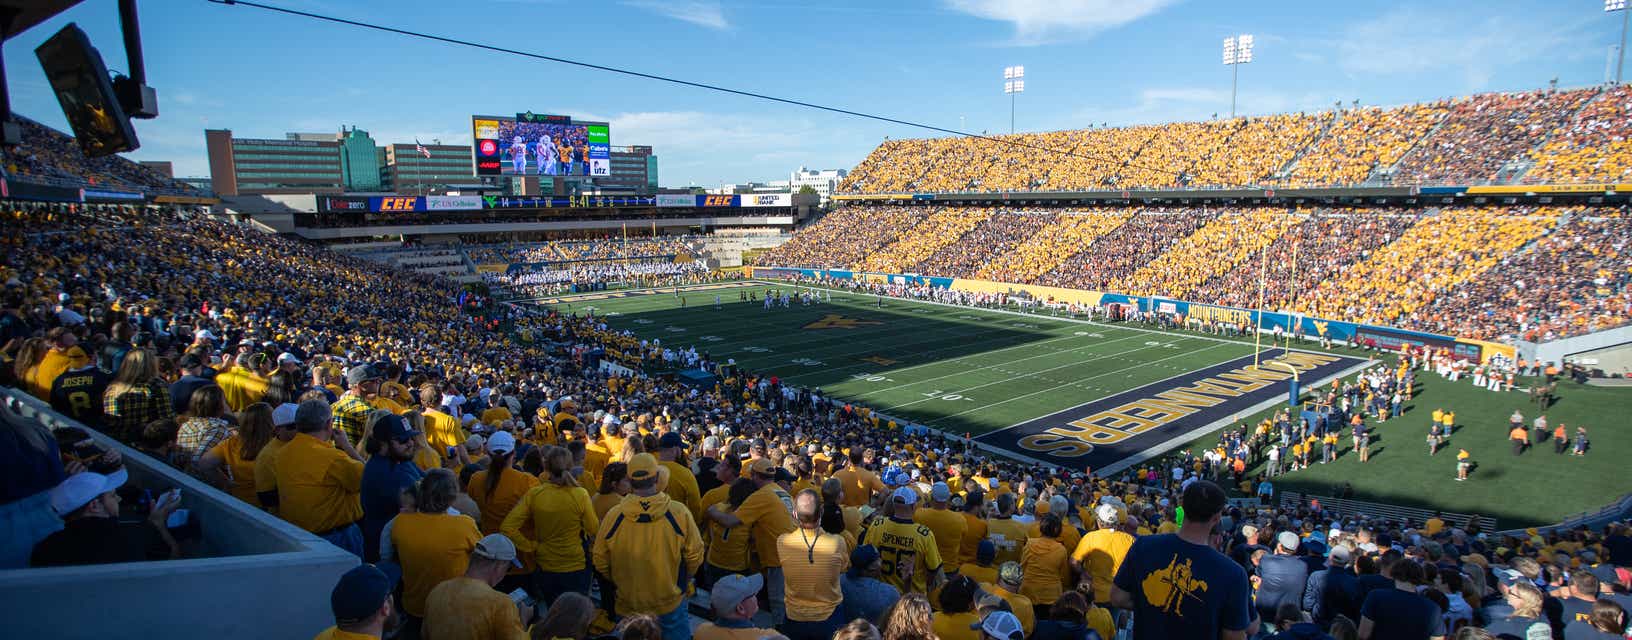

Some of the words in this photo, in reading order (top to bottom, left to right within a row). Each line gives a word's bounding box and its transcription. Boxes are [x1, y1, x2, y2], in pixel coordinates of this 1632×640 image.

[379, 196, 417, 212] CEC
[704, 195, 733, 206] CEC
[1188, 303, 1252, 326] MOUNTAINEERS
[61, 375, 94, 388] JOSEPH
[1017, 351, 1343, 457] MOUNTAINEERS
[881, 532, 914, 547] SPENCER
